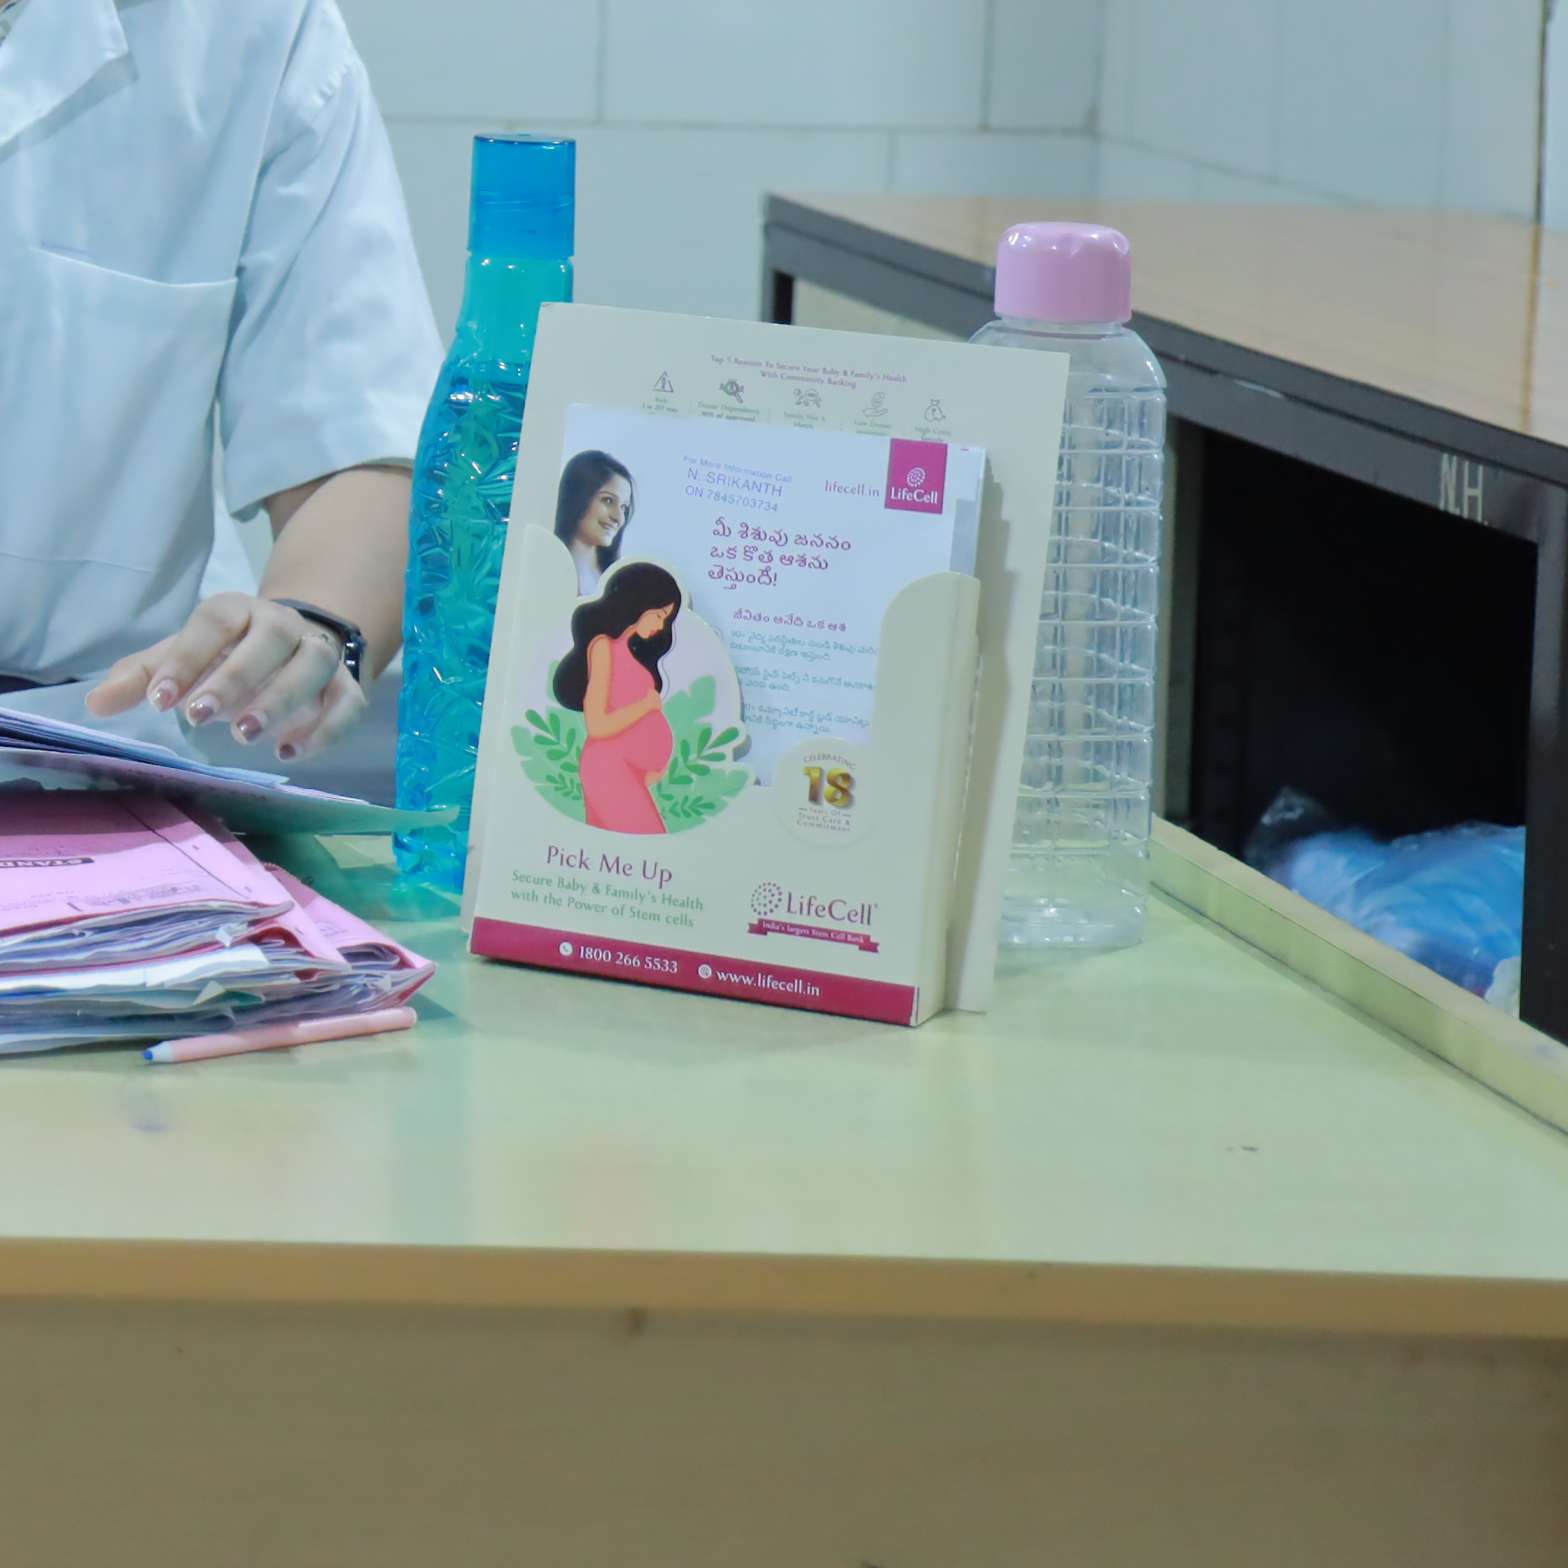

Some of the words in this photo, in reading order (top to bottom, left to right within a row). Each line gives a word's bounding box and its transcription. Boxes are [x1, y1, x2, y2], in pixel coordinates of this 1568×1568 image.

[685, 484, 704, 497] ON
[705, 471, 783, 497] SRIKANTH
[825, 480, 880, 497] lifecell.in
[890, 487, 938, 505] LifeCell
[712, 516, 732, 538] మీ
[794, 533, 851, 551] జననం
[710, 545, 737, 560] ఒక
[803, 766, 854, 809] 18
[546, 844, 591, 871] Pick
[599, 852, 634, 877] Me
[642, 860, 674, 889] Up
[511, 869, 553, 888] Secure
[556, 877, 588, 896] Baby
[591, 882, 602, 895] &
[604, 883, 658, 906] Family's
[661, 892, 705, 912] Health
[510, 888, 539, 904] with
[543, 892, 563, 907] the
[566, 896, 608, 915] Power
[610, 901, 626, 916] of
[629, 904, 661, 925] Stem
[664, 910, 695, 928] cells
[786, 892, 874, 926] LifeCell
[579, 945, 612, 963] 1800
[615, 950, 642, 967] 266
[644, 955, 678, 974] 5533
[716, 969, 821, 997] www.lifecell.in
